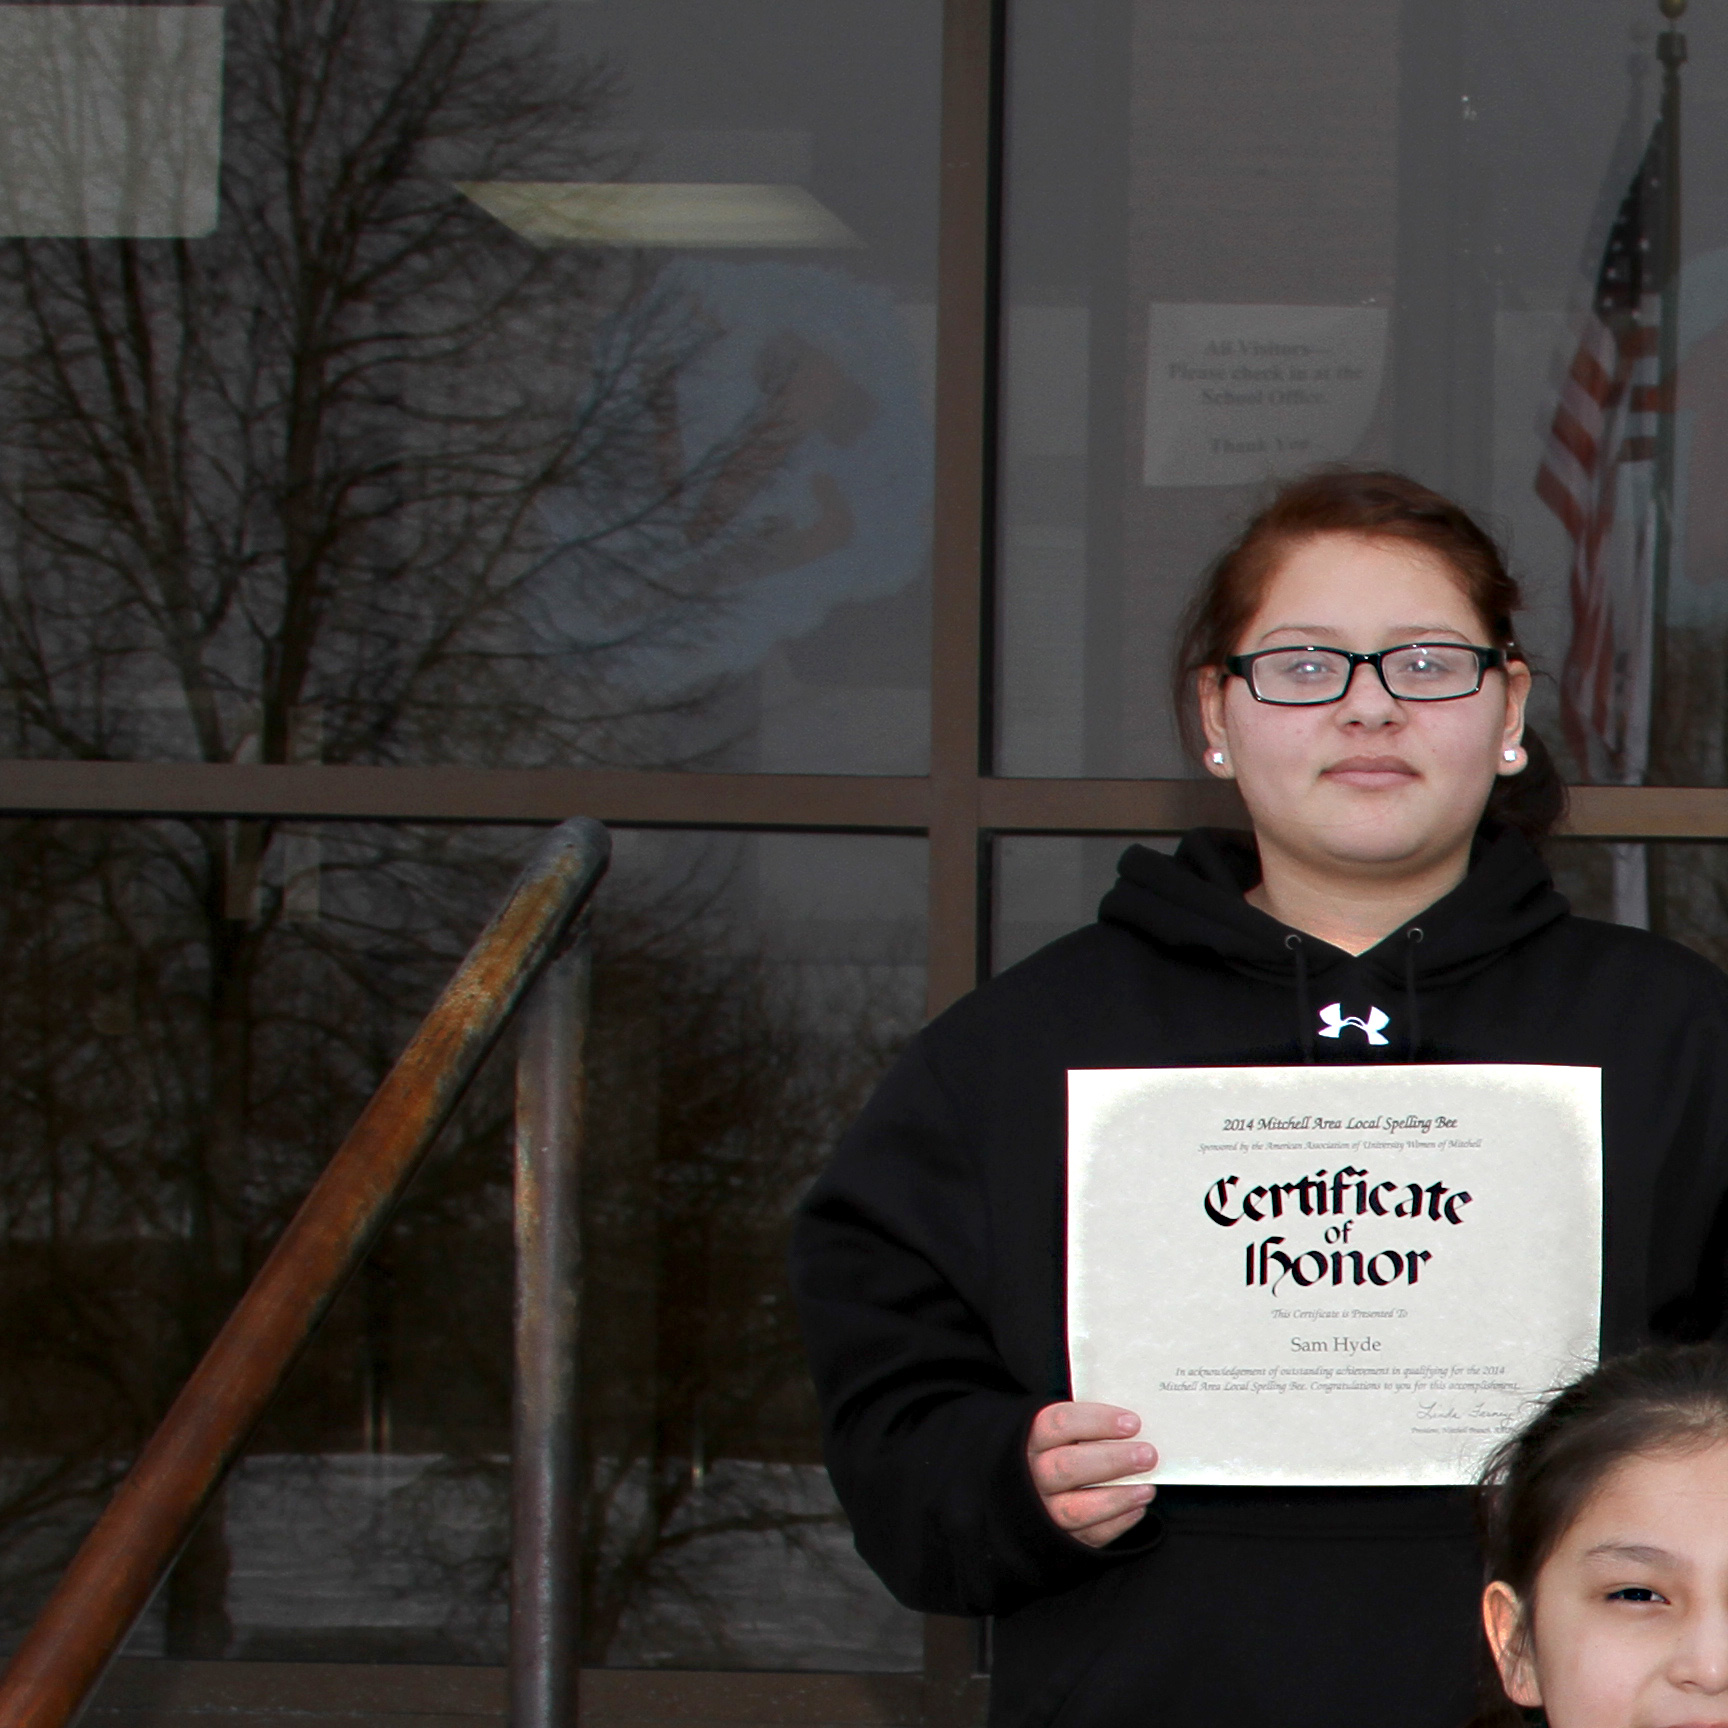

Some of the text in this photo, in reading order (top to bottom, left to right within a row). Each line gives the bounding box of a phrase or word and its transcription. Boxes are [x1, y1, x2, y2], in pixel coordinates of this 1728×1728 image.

[1169, 363, 1225, 380] Please
[1202, 390, 1262, 404] School
[1212, 437, 1265, 453] Thank
[1222, 1115, 1458, 1134] 2014 Mitchell Area Local Spelling Bee
[1204, 1165, 1473, 1229] Certificate
[1324, 1220, 1354, 1244] of
[1246, 1235, 1433, 1298] Honor
[1291, 1336, 1381, 1357] Sam Hyde
